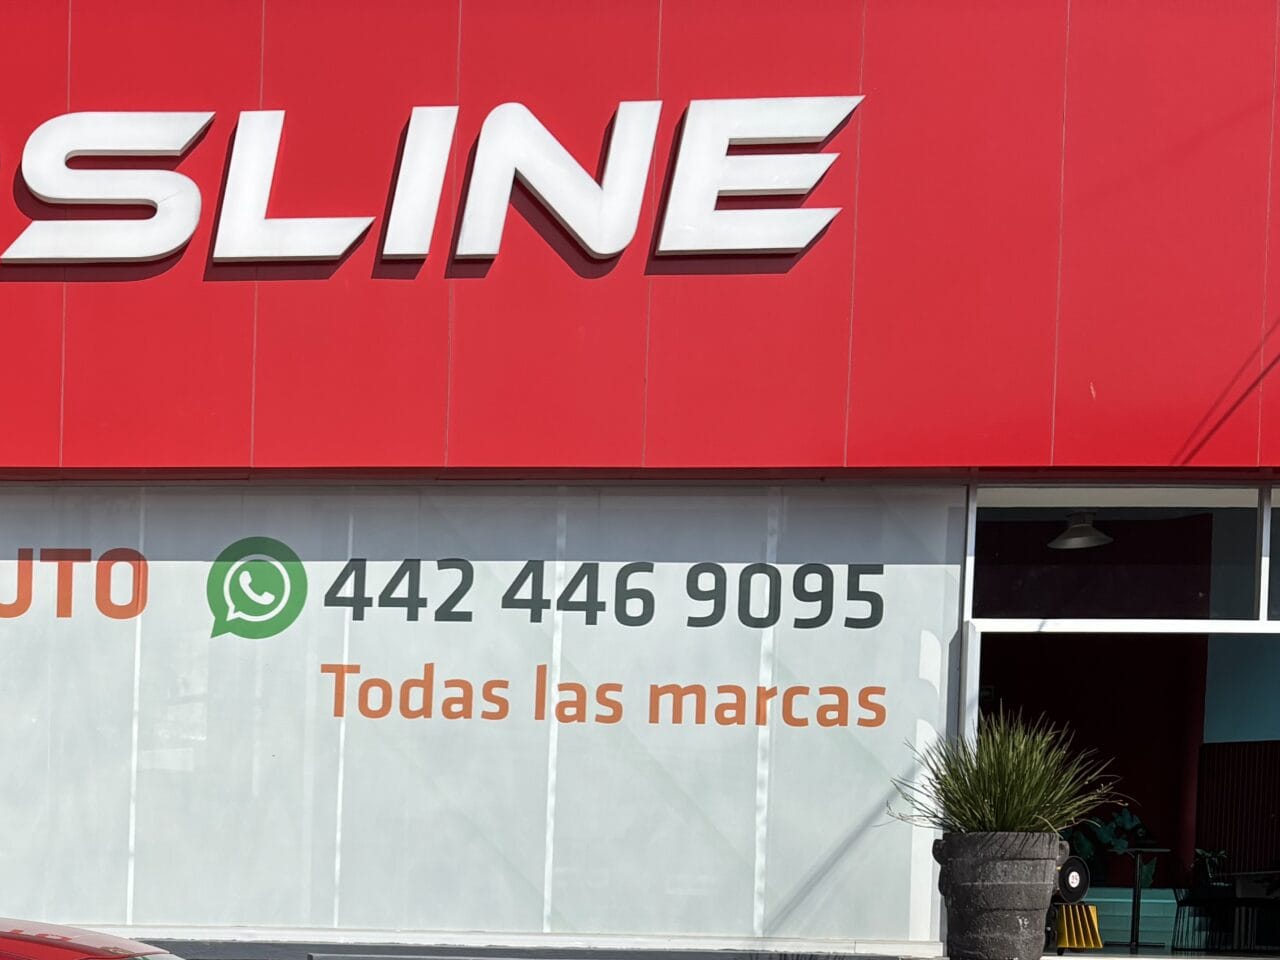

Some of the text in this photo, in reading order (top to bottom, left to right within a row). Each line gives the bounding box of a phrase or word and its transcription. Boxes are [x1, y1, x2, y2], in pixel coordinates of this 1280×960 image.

[324, 557, 885, 630] 442 446 9095
[320, 662, 887, 729] Todas las marcas
